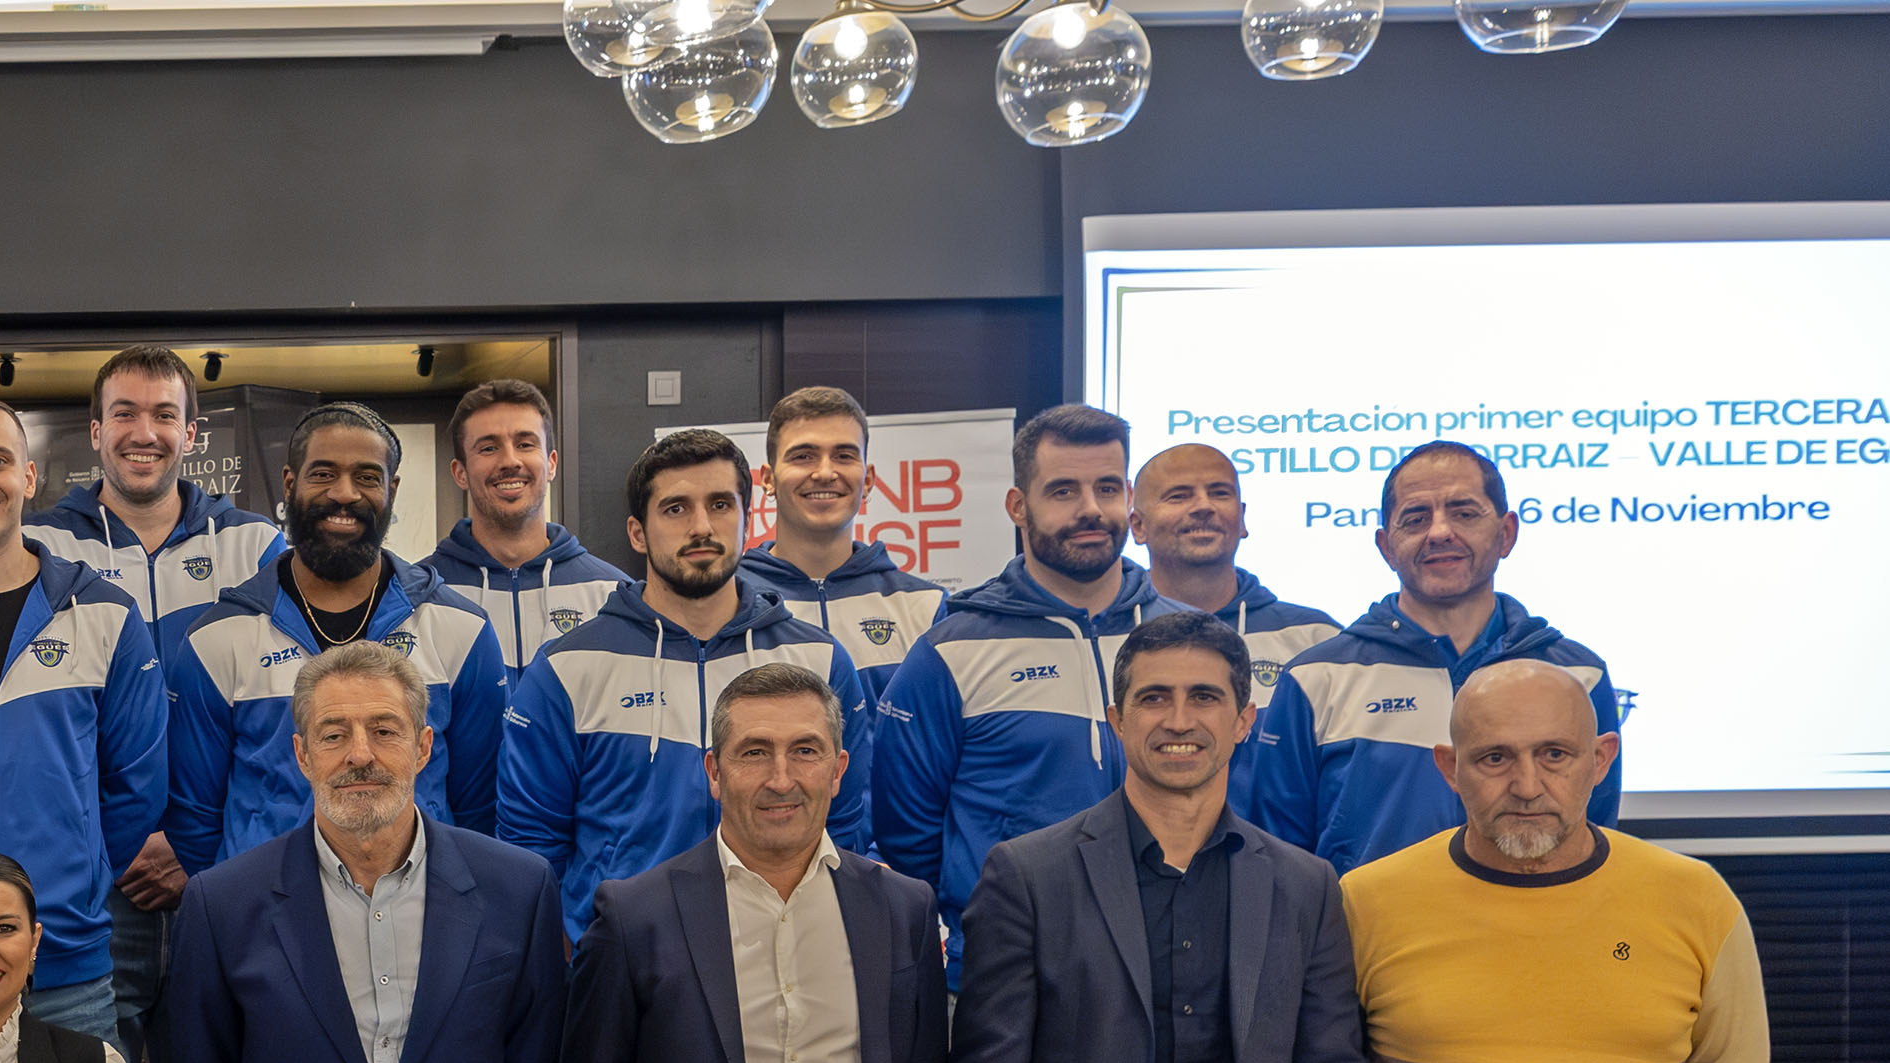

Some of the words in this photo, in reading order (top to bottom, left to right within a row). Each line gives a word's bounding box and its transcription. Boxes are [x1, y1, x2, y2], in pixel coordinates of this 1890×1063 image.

[1435, 403, 1564, 438] primer
[1571, 400, 1699, 435] equipo
[1705, 397, 1890, 426] TERCERA
[222, 456, 243, 471] DE
[1230, 445, 1361, 475] STILLO
[1470, 442, 1610, 469] RRAIZ
[1648, 439, 1768, 467] VALLE
[1775, 439, 1828, 466] DE
[1518, 497, 1543, 525] 6
[1551, 495, 1601, 525] de
[1610, 493, 1831, 524] Noviembre
[272, 646, 301, 662] BZK
[1025, 664, 1058, 678] BZK
[1381, 696, 1416, 710] BZK
